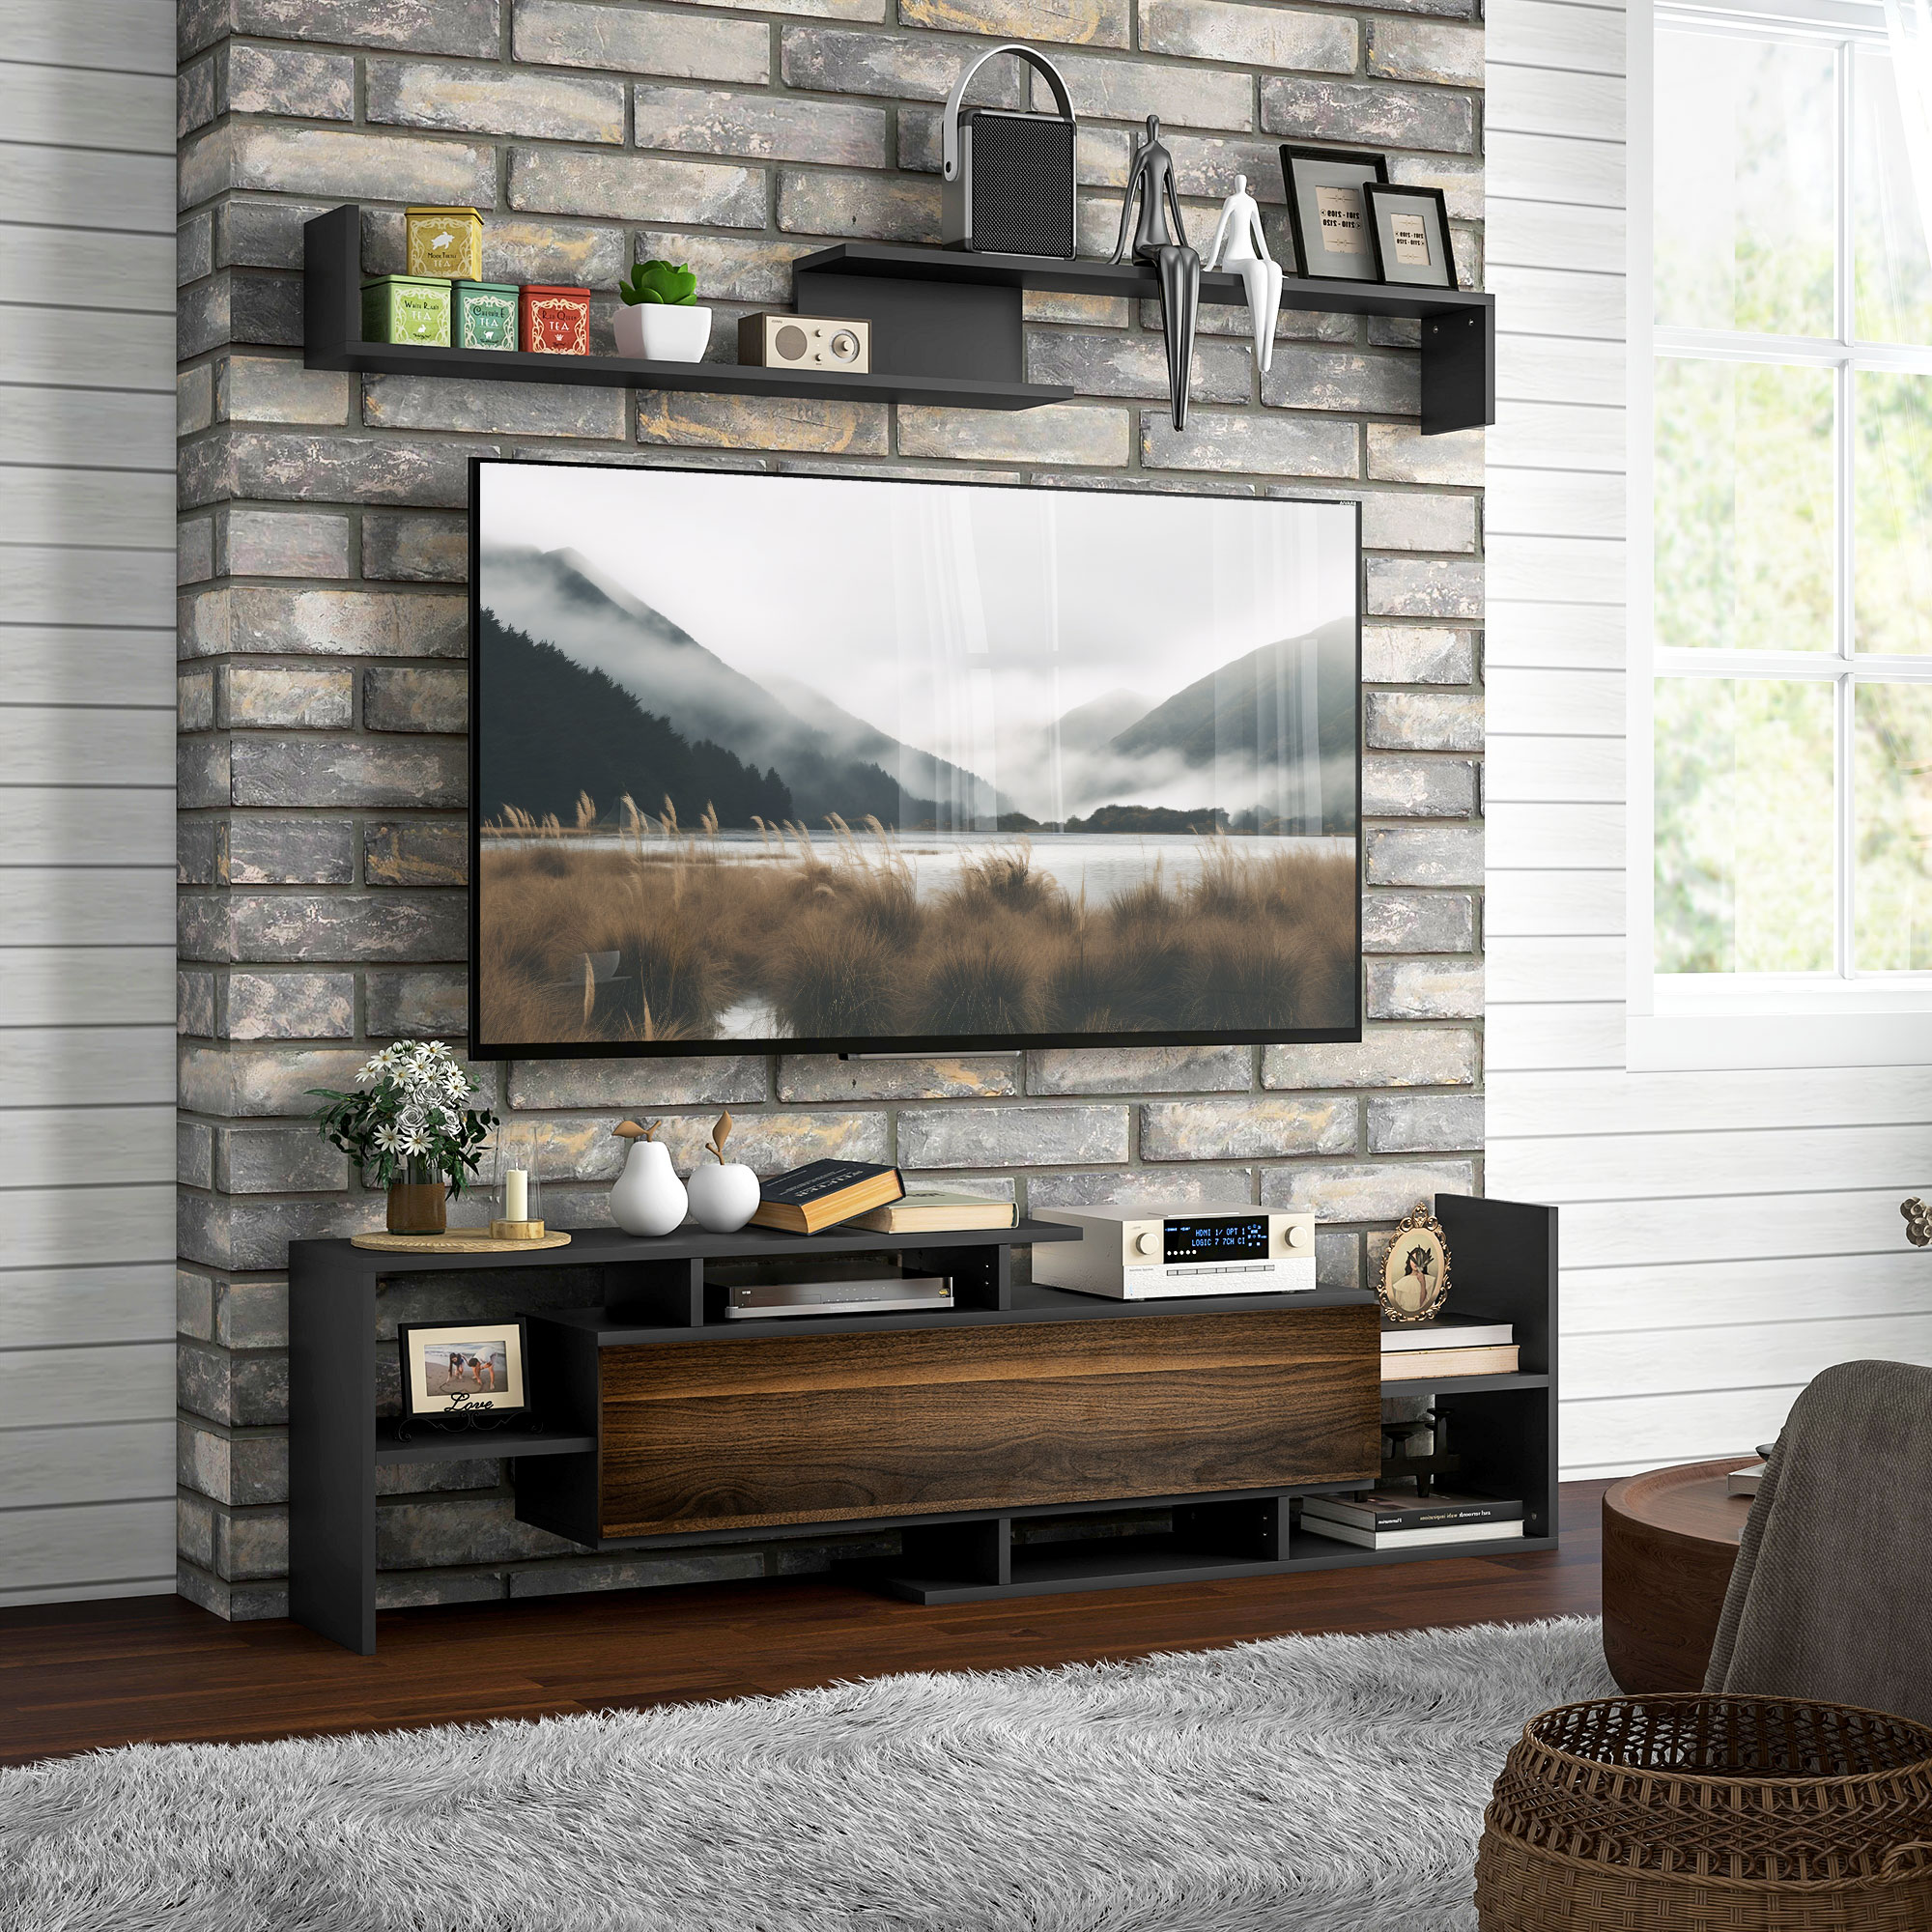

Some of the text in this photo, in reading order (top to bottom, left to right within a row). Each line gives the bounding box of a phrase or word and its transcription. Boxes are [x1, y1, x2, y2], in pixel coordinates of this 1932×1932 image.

[412, 310, 432, 321] TEA
[479, 317, 498, 327] TEA
[549, 321, 570, 331] TEA
[1226, 1227, 1238, 1236] OPT
[1191, 1238, 1212, 1247] LOGIC
[443, 1392, 494, 1411] Love
